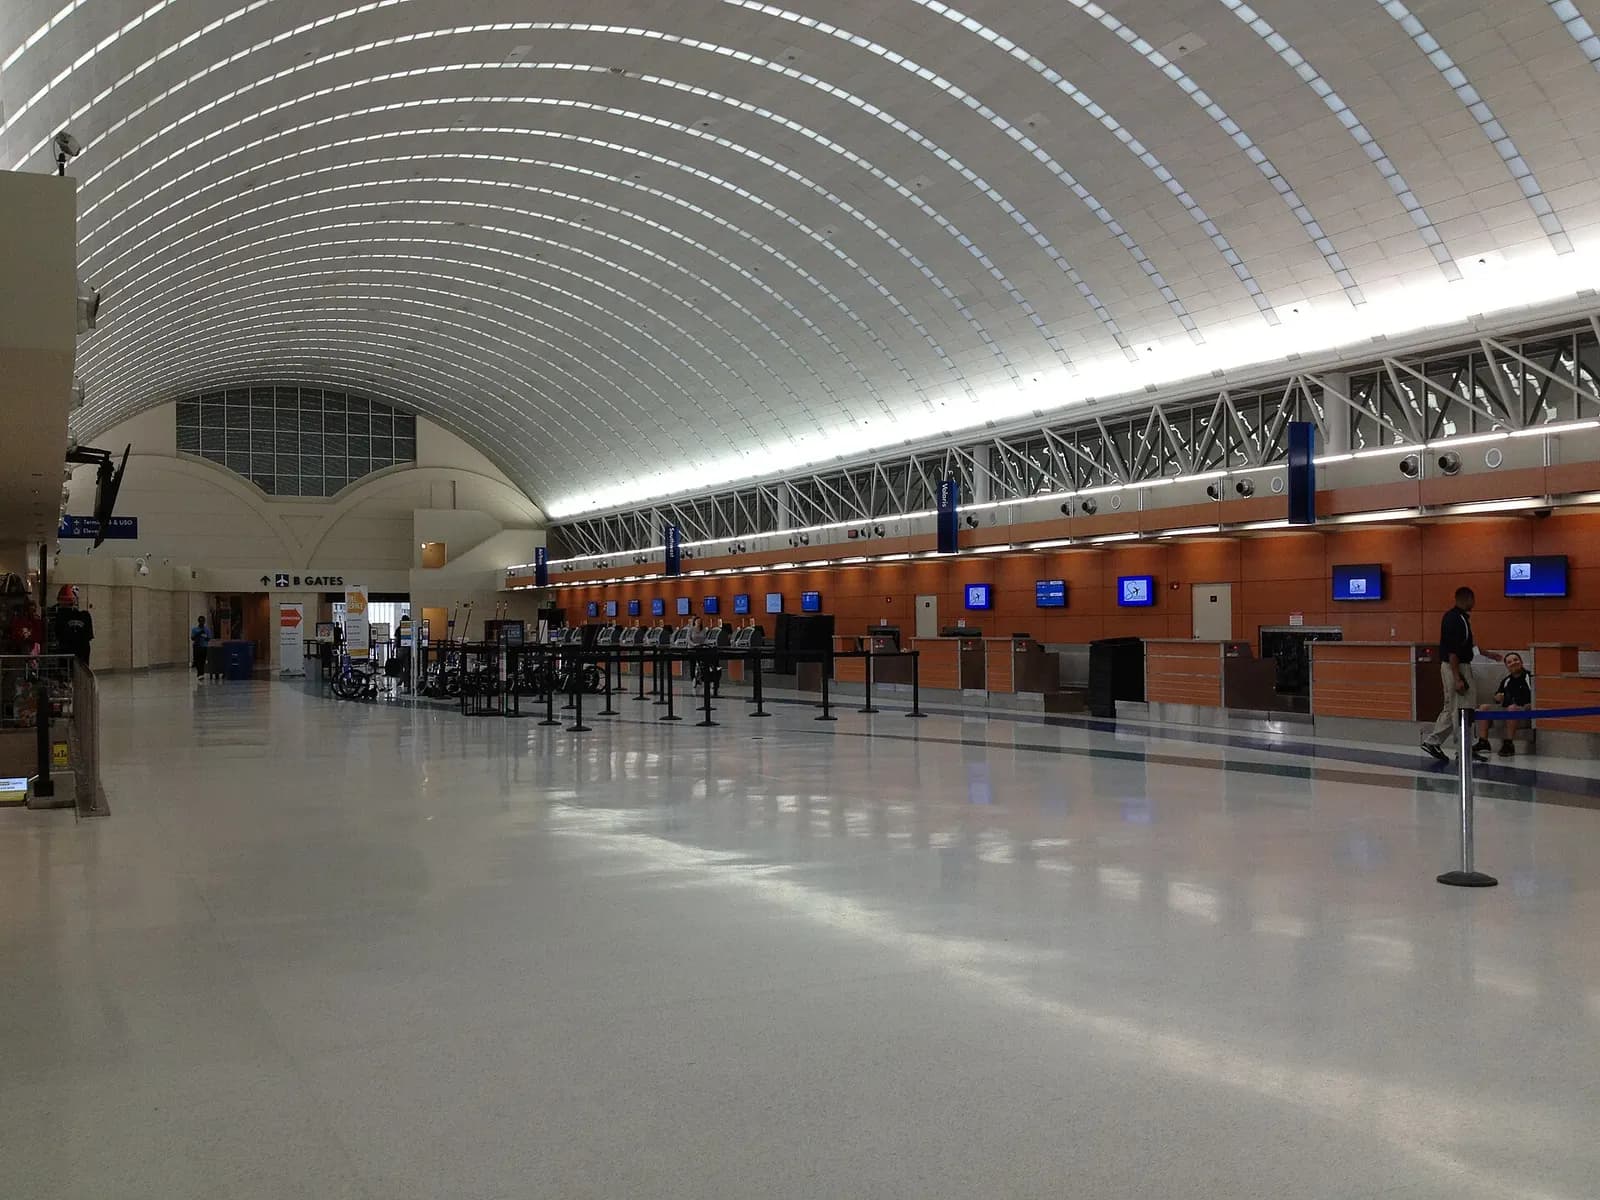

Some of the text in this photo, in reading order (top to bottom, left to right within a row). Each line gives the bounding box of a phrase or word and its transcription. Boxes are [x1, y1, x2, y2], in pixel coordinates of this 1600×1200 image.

[941, 483, 949, 508] Volaris
[293, 576, 344, 586] B GATES
